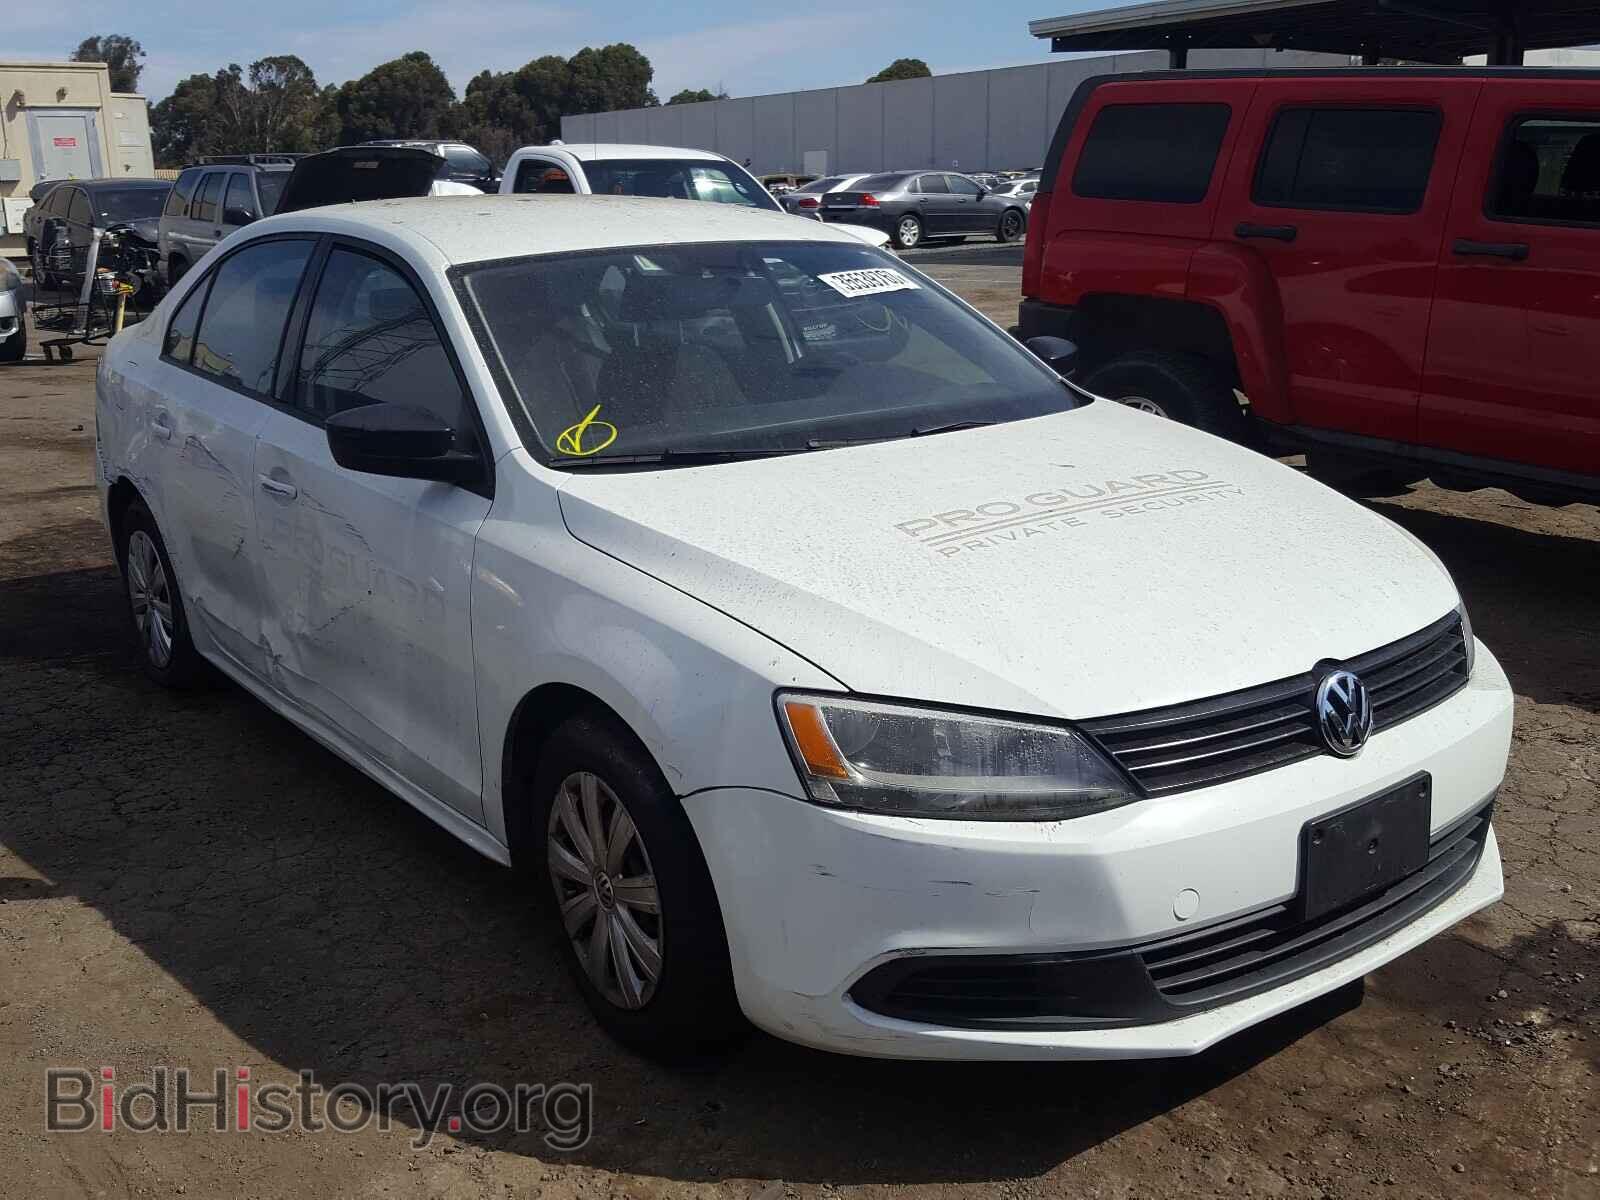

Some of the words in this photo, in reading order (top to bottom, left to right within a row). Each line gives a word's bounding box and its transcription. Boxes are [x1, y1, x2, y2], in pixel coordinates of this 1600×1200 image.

[894, 501, 1021, 537] PRO
[1024, 470, 1208, 506] GUARD
[936, 516, 1089, 558] PRIVATE
[1101, 488, 1246, 519] SECURITY
[1318, 671, 1369, 754] VW
